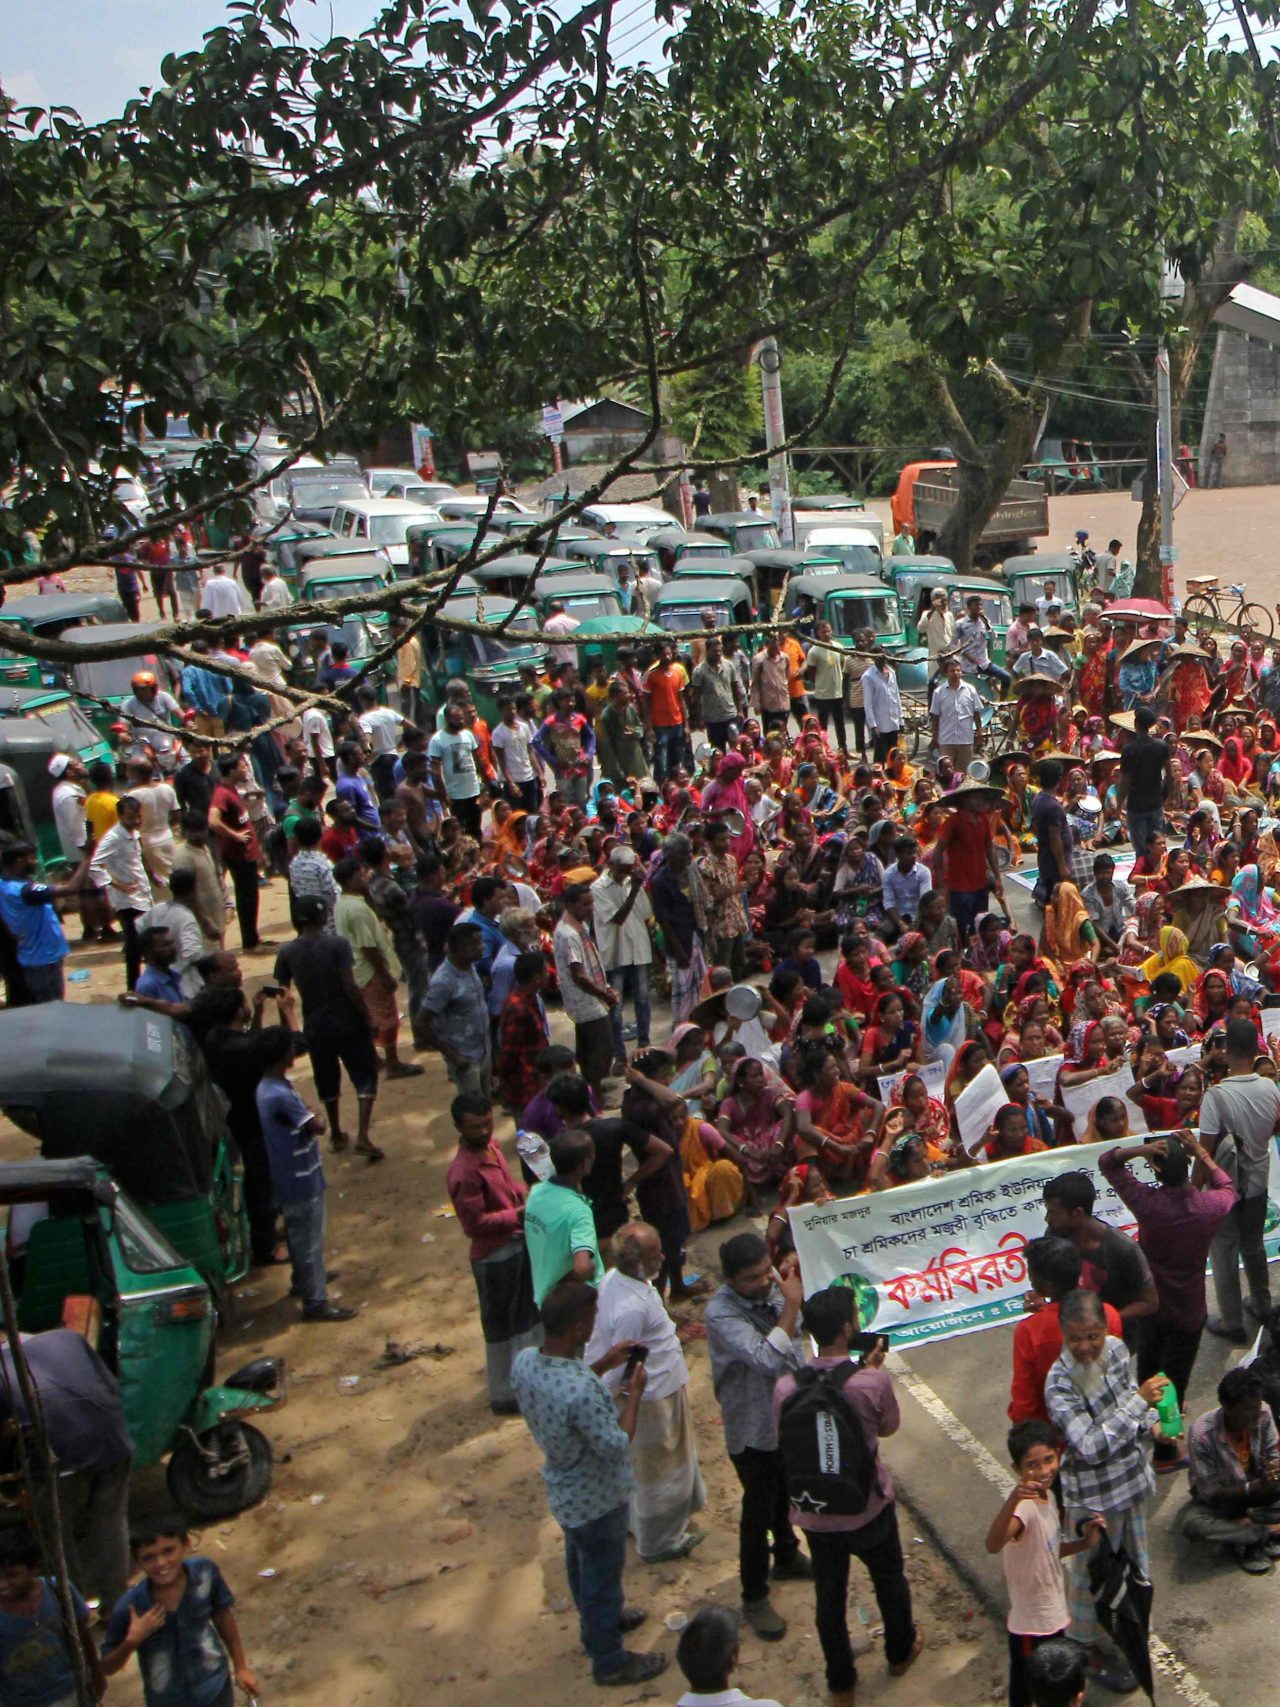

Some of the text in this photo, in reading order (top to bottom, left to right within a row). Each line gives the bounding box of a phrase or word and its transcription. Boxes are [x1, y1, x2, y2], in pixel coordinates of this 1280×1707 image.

[890, 1200, 954, 1225] বাংলাদেশ
[958, 1189, 997, 1208] শ্রমিক
[842, 1245, 857, 1260] চা
[861, 1228, 927, 1254] শ্রমিকদের
